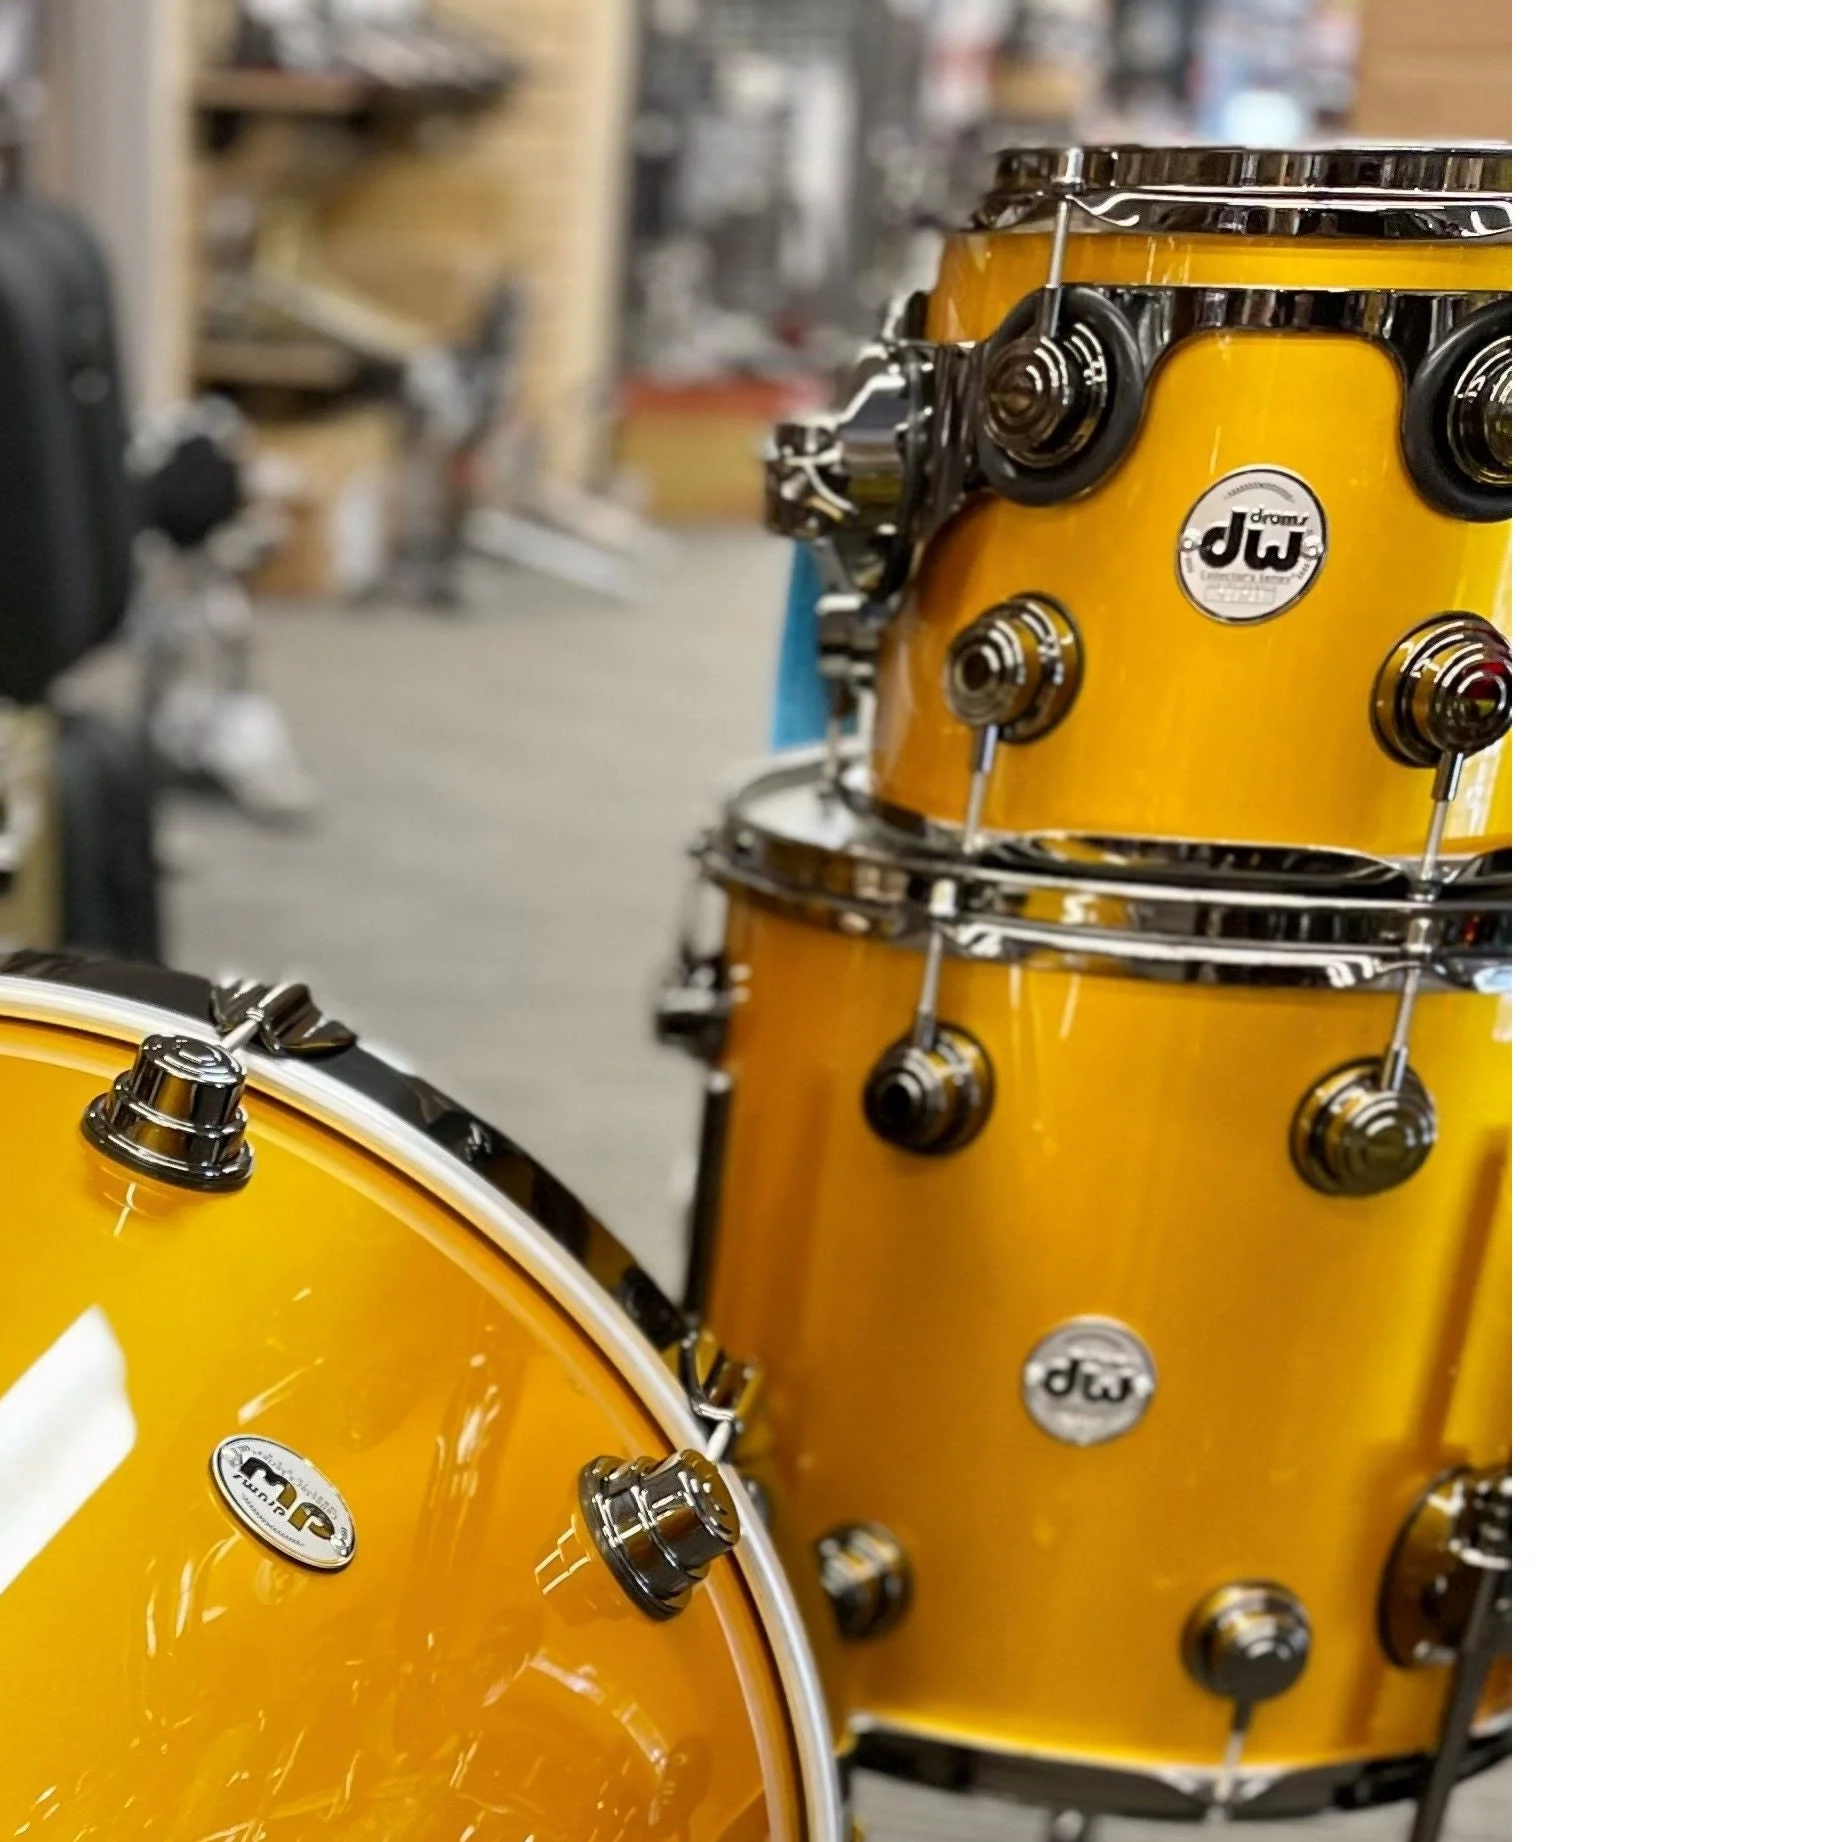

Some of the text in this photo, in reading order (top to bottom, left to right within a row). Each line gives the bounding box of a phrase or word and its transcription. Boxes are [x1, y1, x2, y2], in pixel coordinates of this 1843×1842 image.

[1250, 506, 1308, 526] drums
[1199, 511, 1305, 572] dw
[1044, 1359, 1133, 1403] dw
[232, 1474, 286, 1517] drums
[240, 1457, 336, 1541] dw
